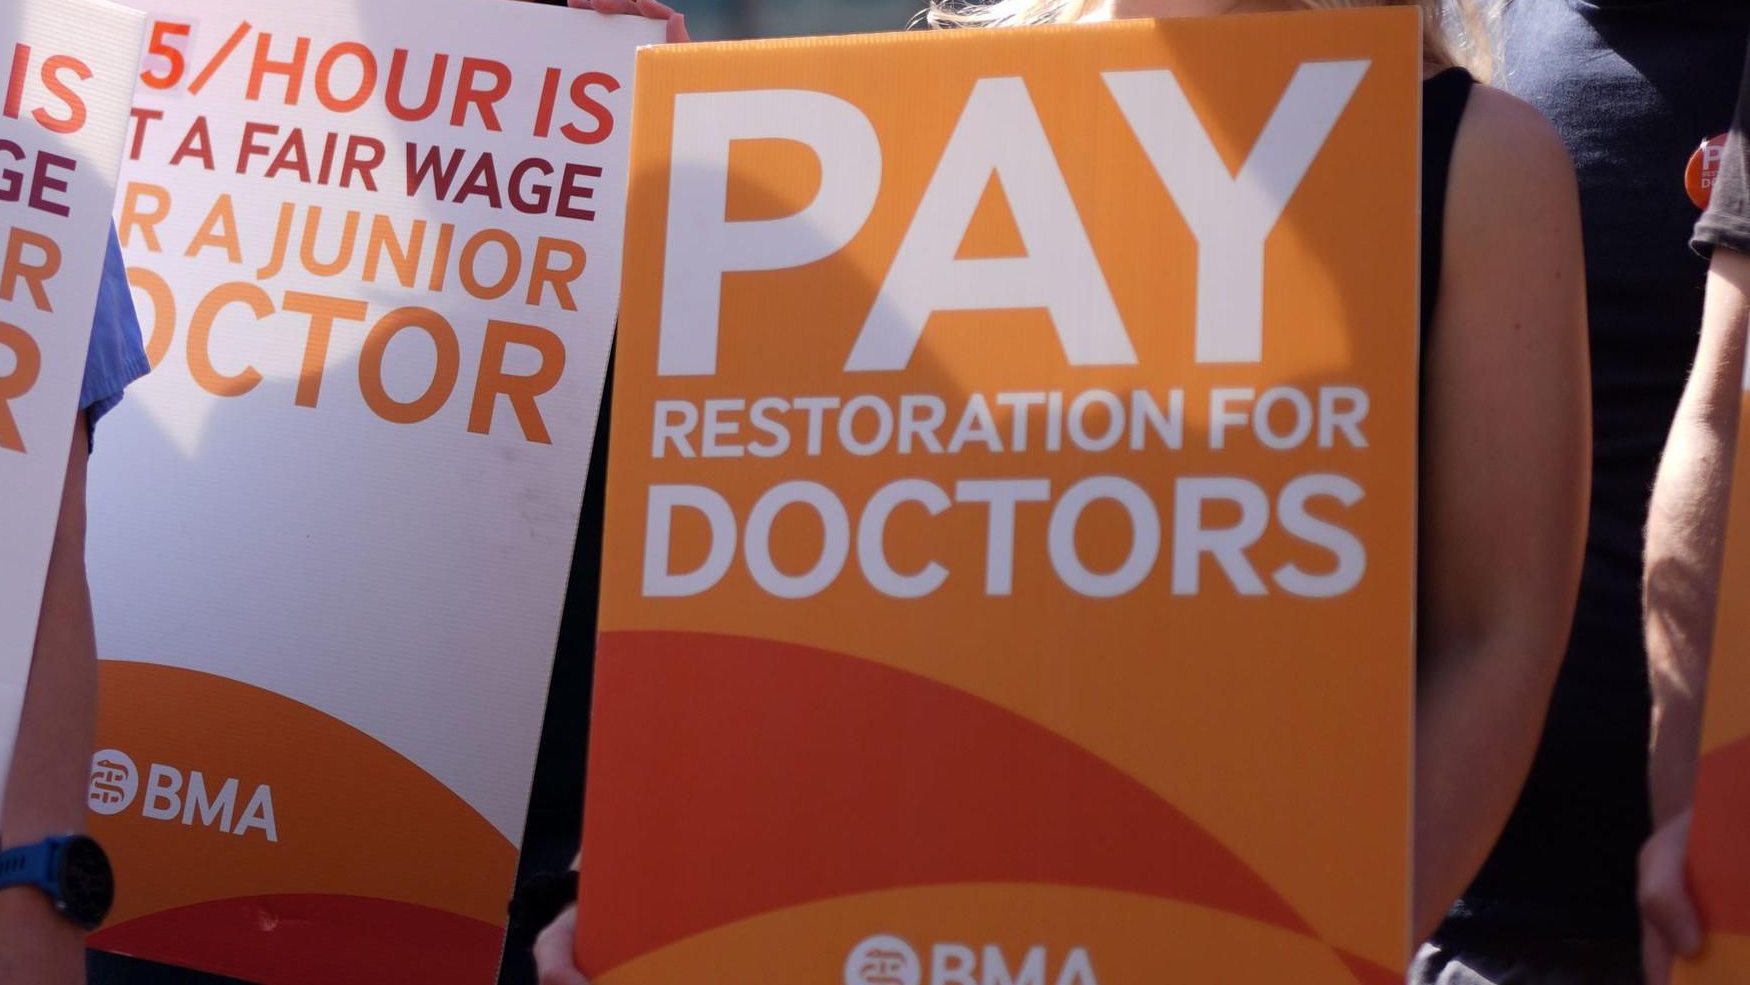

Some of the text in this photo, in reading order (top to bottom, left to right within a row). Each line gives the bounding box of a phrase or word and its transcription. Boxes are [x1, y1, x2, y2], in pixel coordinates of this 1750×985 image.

[4, 44, 92, 134] IS
[139, 20, 620, 144] 5/HOUR IS
[170, 115, 214, 170] A
[236, 121, 384, 191] FAIR
[404, 142, 602, 221] WAGE
[656, 58, 1372, 377] PAY
[184, 193, 242, 263] A
[258, 201, 586, 312] JUNIOR
[127, 268, 566, 445] CTOR
[651, 386, 1370, 459] RESTORATION FOR
[641, 474, 1368, 601] DOCTORS
[142, 763, 278, 842] BMA
[931, 943, 1101, 985] BMA
